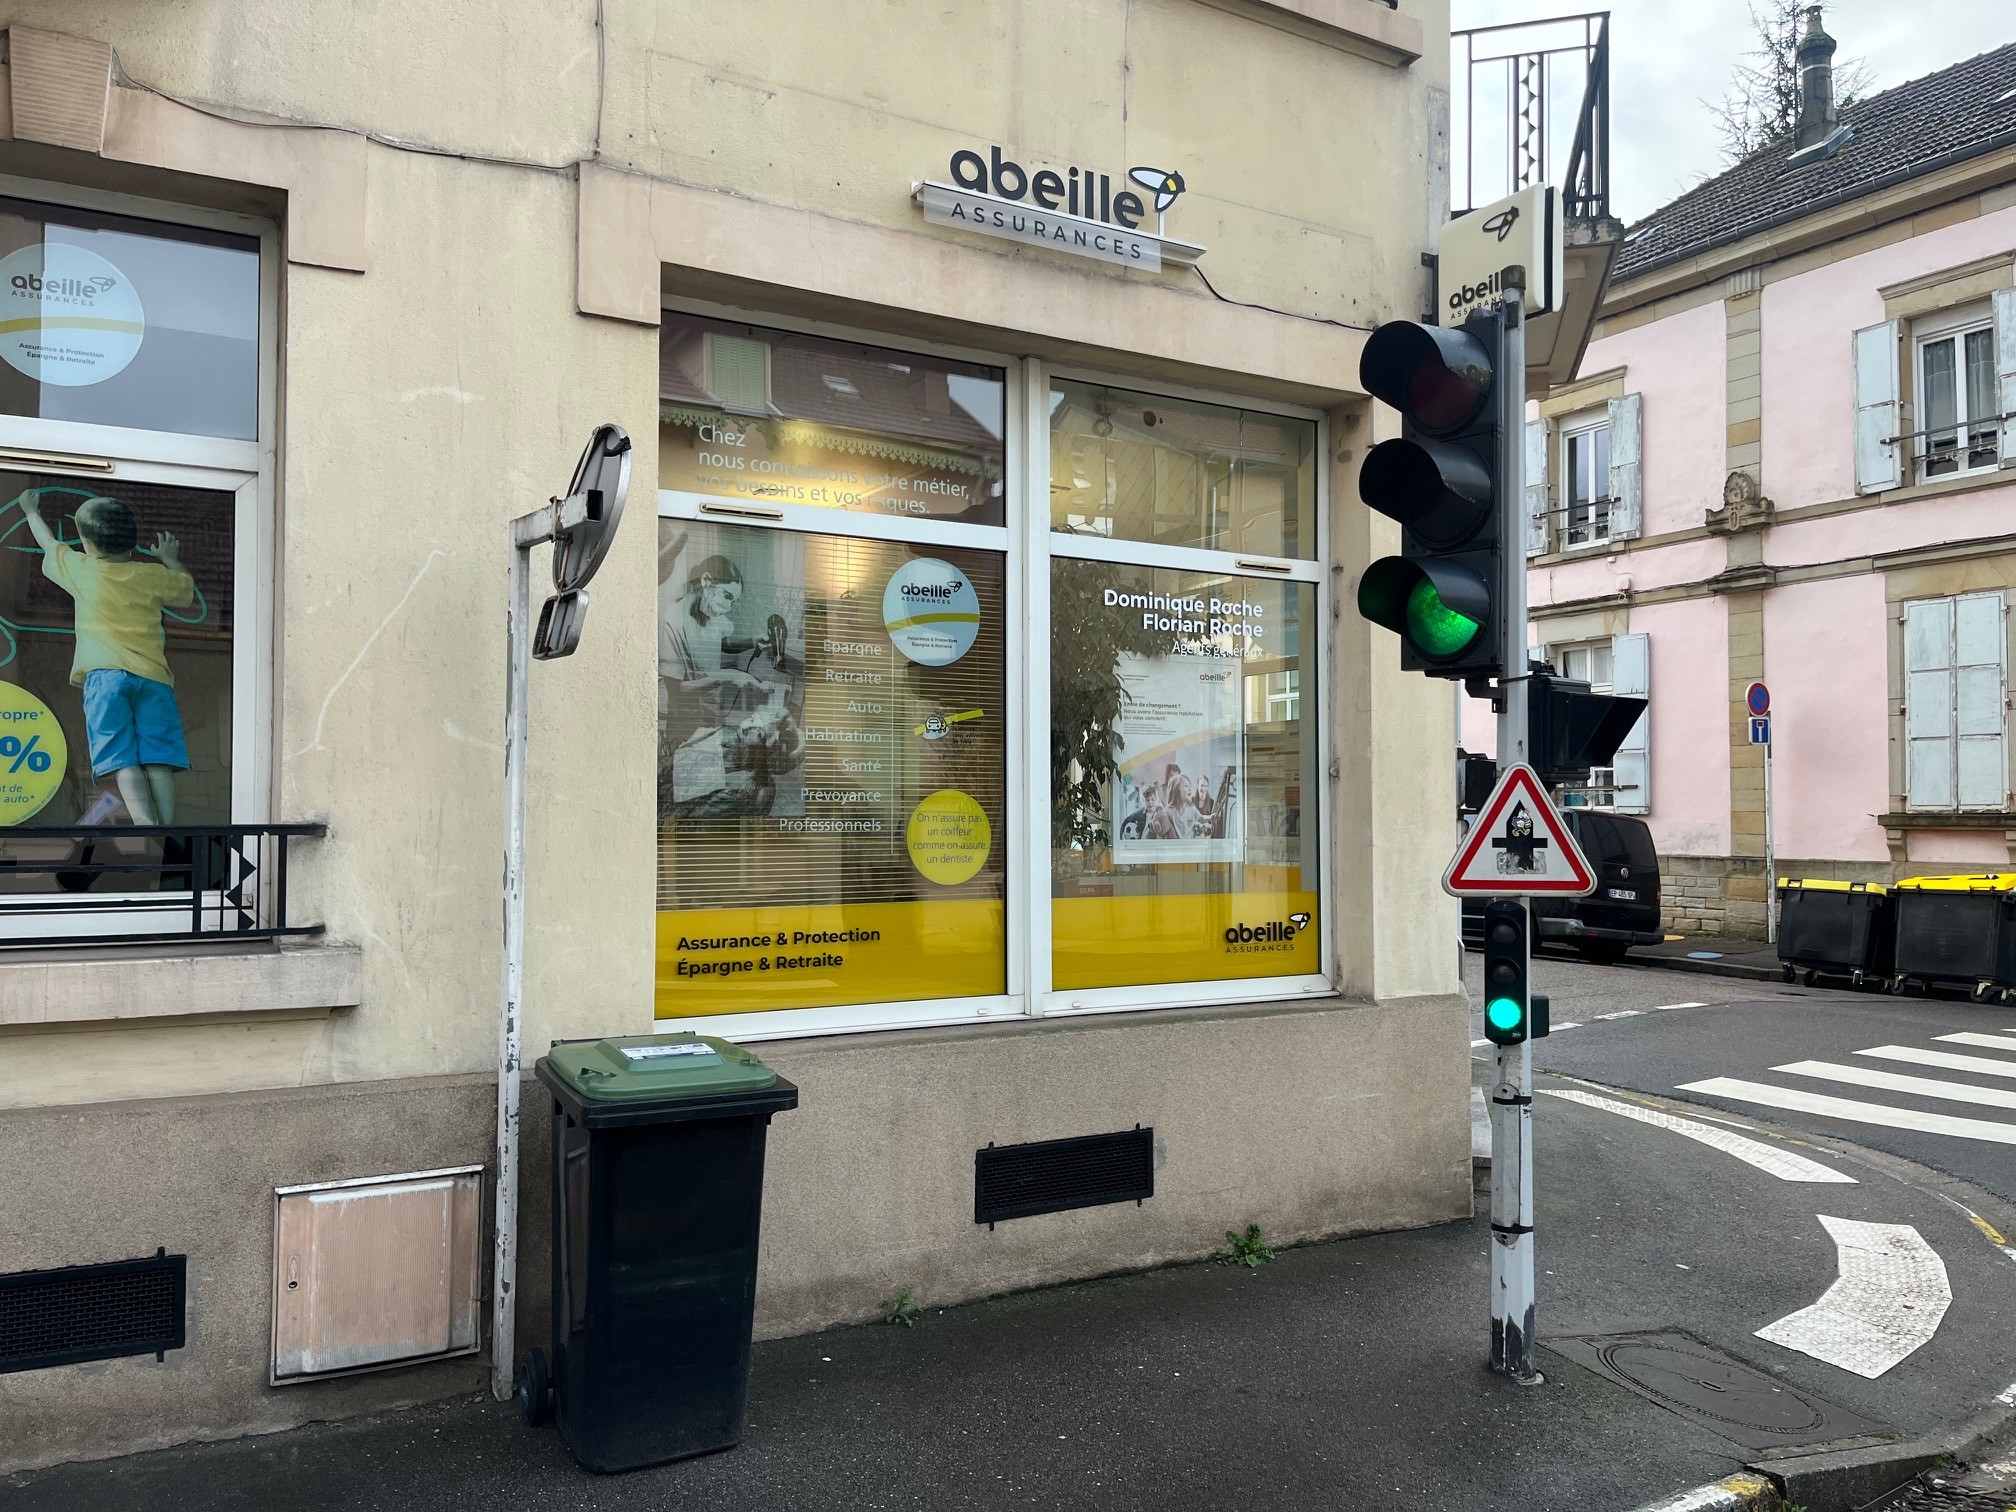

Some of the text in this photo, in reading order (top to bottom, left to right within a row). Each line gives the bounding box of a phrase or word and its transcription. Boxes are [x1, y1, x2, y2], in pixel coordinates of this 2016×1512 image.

[950, 145, 1144, 230] abeille
[951, 202, 1141, 258] ASSURANCES
[11, 274, 97, 298] abeille
[1449, 272, 1500, 309] abeil
[11, 290, 94, 306] ASSURANCES
[1451, 294, 1503, 319] ASSRANC
[19, 343, 57, 353] Assurance
[66, 348, 104, 358] Protection
[66, 356, 95, 365] Retraite
[699, 424, 746, 447] Chez
[699, 452, 969, 500] nous connaissons votre métier,
[736, 475, 804, 499] besoins
[810, 487, 828, 502] et
[833, 491, 862, 505] vos
[868, 495, 930, 514] risques.
[901, 583, 951, 598] abeille
[1104, 589, 1263, 618] Dominique Roche
[1143, 613, 1264, 638] Florian Roche
[1172, 641, 1211, 656] Agents
[825, 669, 882, 684] Retraite
[1200, 673, 1225, 682] abeille
[847, 700, 881, 714] Auto
[0, 711, 44, 722] opre
[805, 727, 881, 743] Habitation
[842, 759, 881, 772] Santé
[800, 788, 881, 805] Prévoyance
[780, 817, 881, 831] Professionnels
[917, 813, 983, 824] On n'assure pas
[941, 827, 973, 836] coiffeur
[960, 842, 986, 850] assure
[926, 854, 973, 863] un dentiste
[677, 928, 880, 951] Assurance & Protection
[1225, 922, 1296, 944] abeille
[1226, 944, 1295, 954] ASSURANCES
[677, 952, 843, 978] Épargne & Retraite
